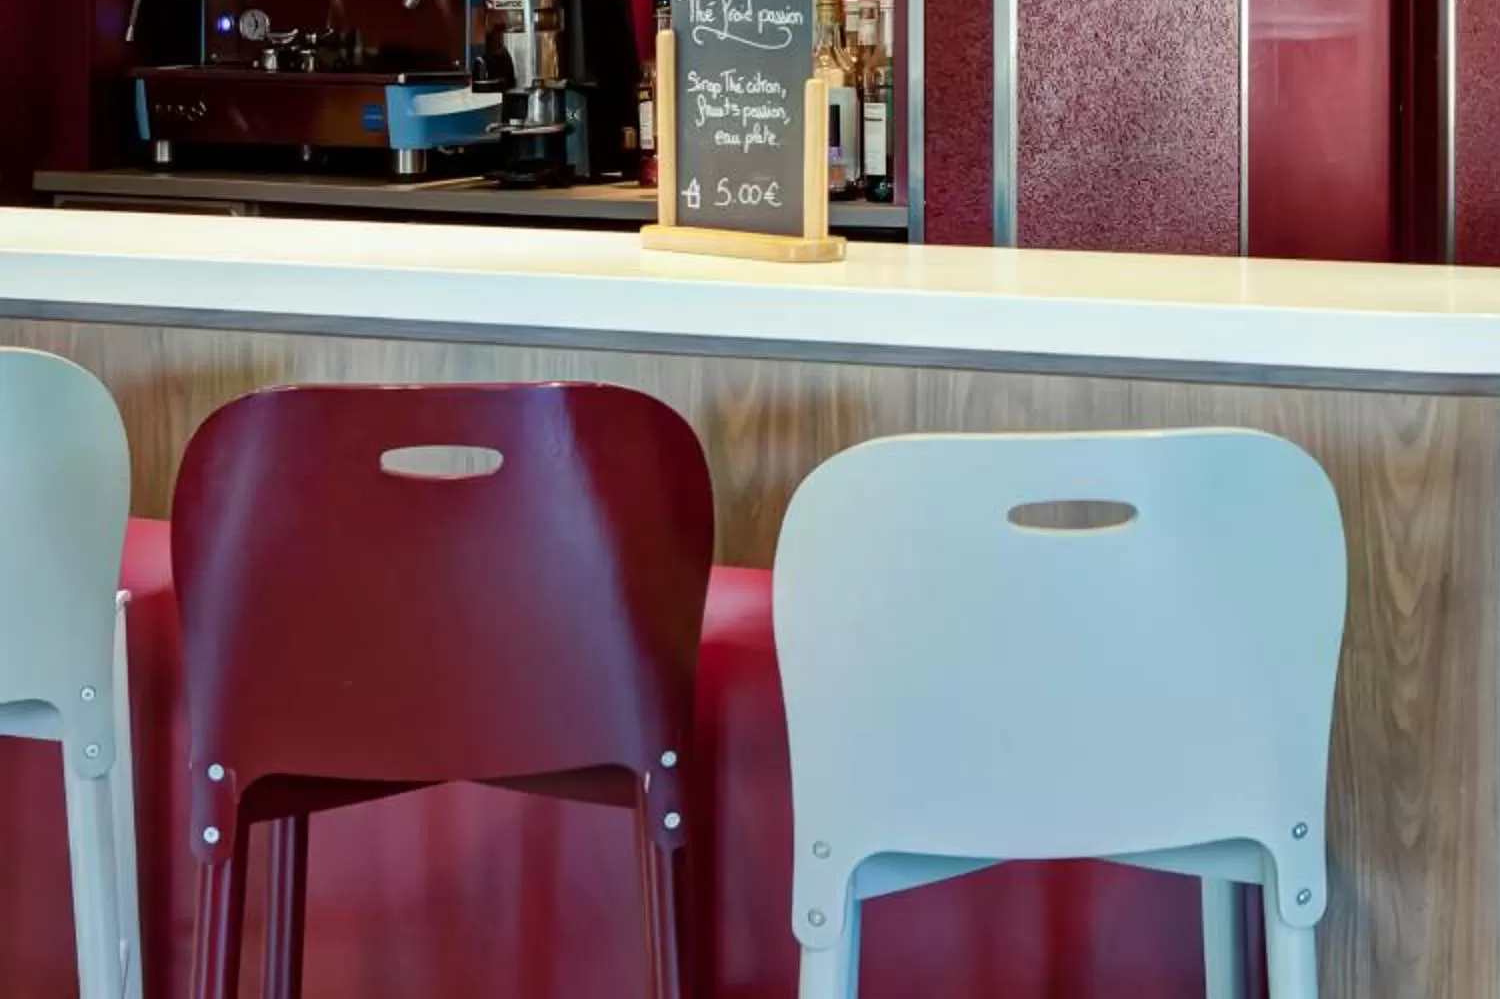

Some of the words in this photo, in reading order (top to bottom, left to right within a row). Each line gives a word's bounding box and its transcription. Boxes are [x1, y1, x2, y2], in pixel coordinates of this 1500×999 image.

[757, 5, 803, 34] passion
[719, 68, 744, 94] Thé
[714, 129, 741, 146] eau
